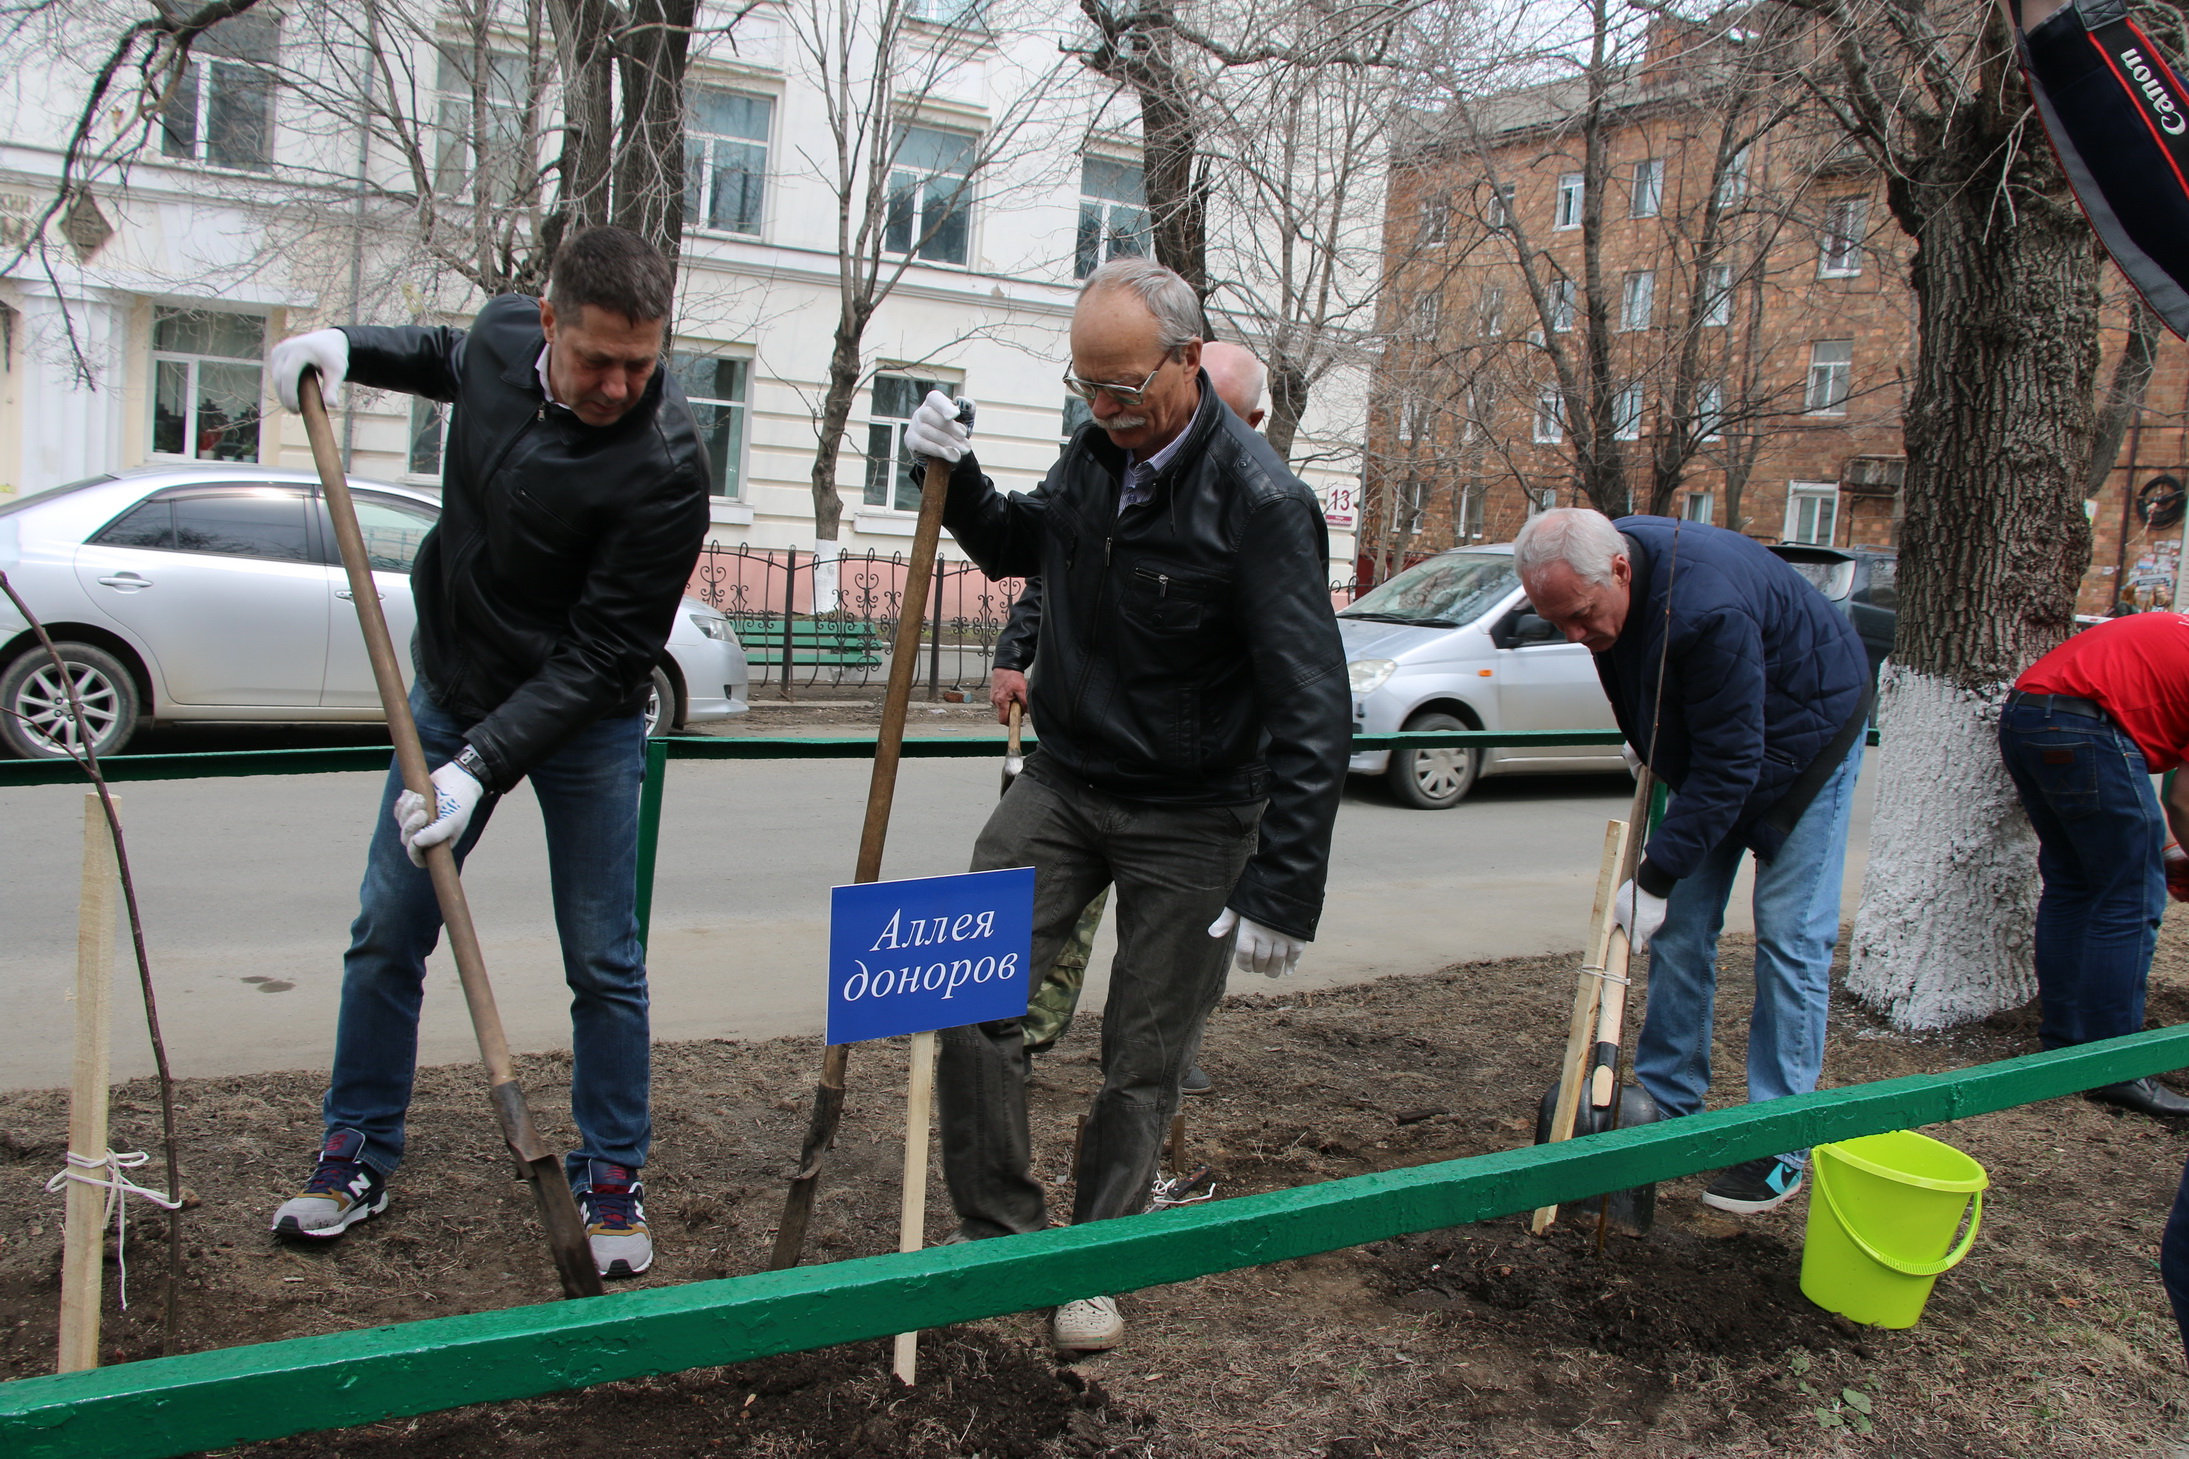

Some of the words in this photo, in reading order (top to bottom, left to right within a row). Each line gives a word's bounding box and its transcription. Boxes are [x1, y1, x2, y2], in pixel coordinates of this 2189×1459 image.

[2120, 48, 2186, 135] Canon
[1331, 489, 1350, 511] 13
[868, 908, 996, 952] Аллея
[843, 952, 1019, 1002] доноров
